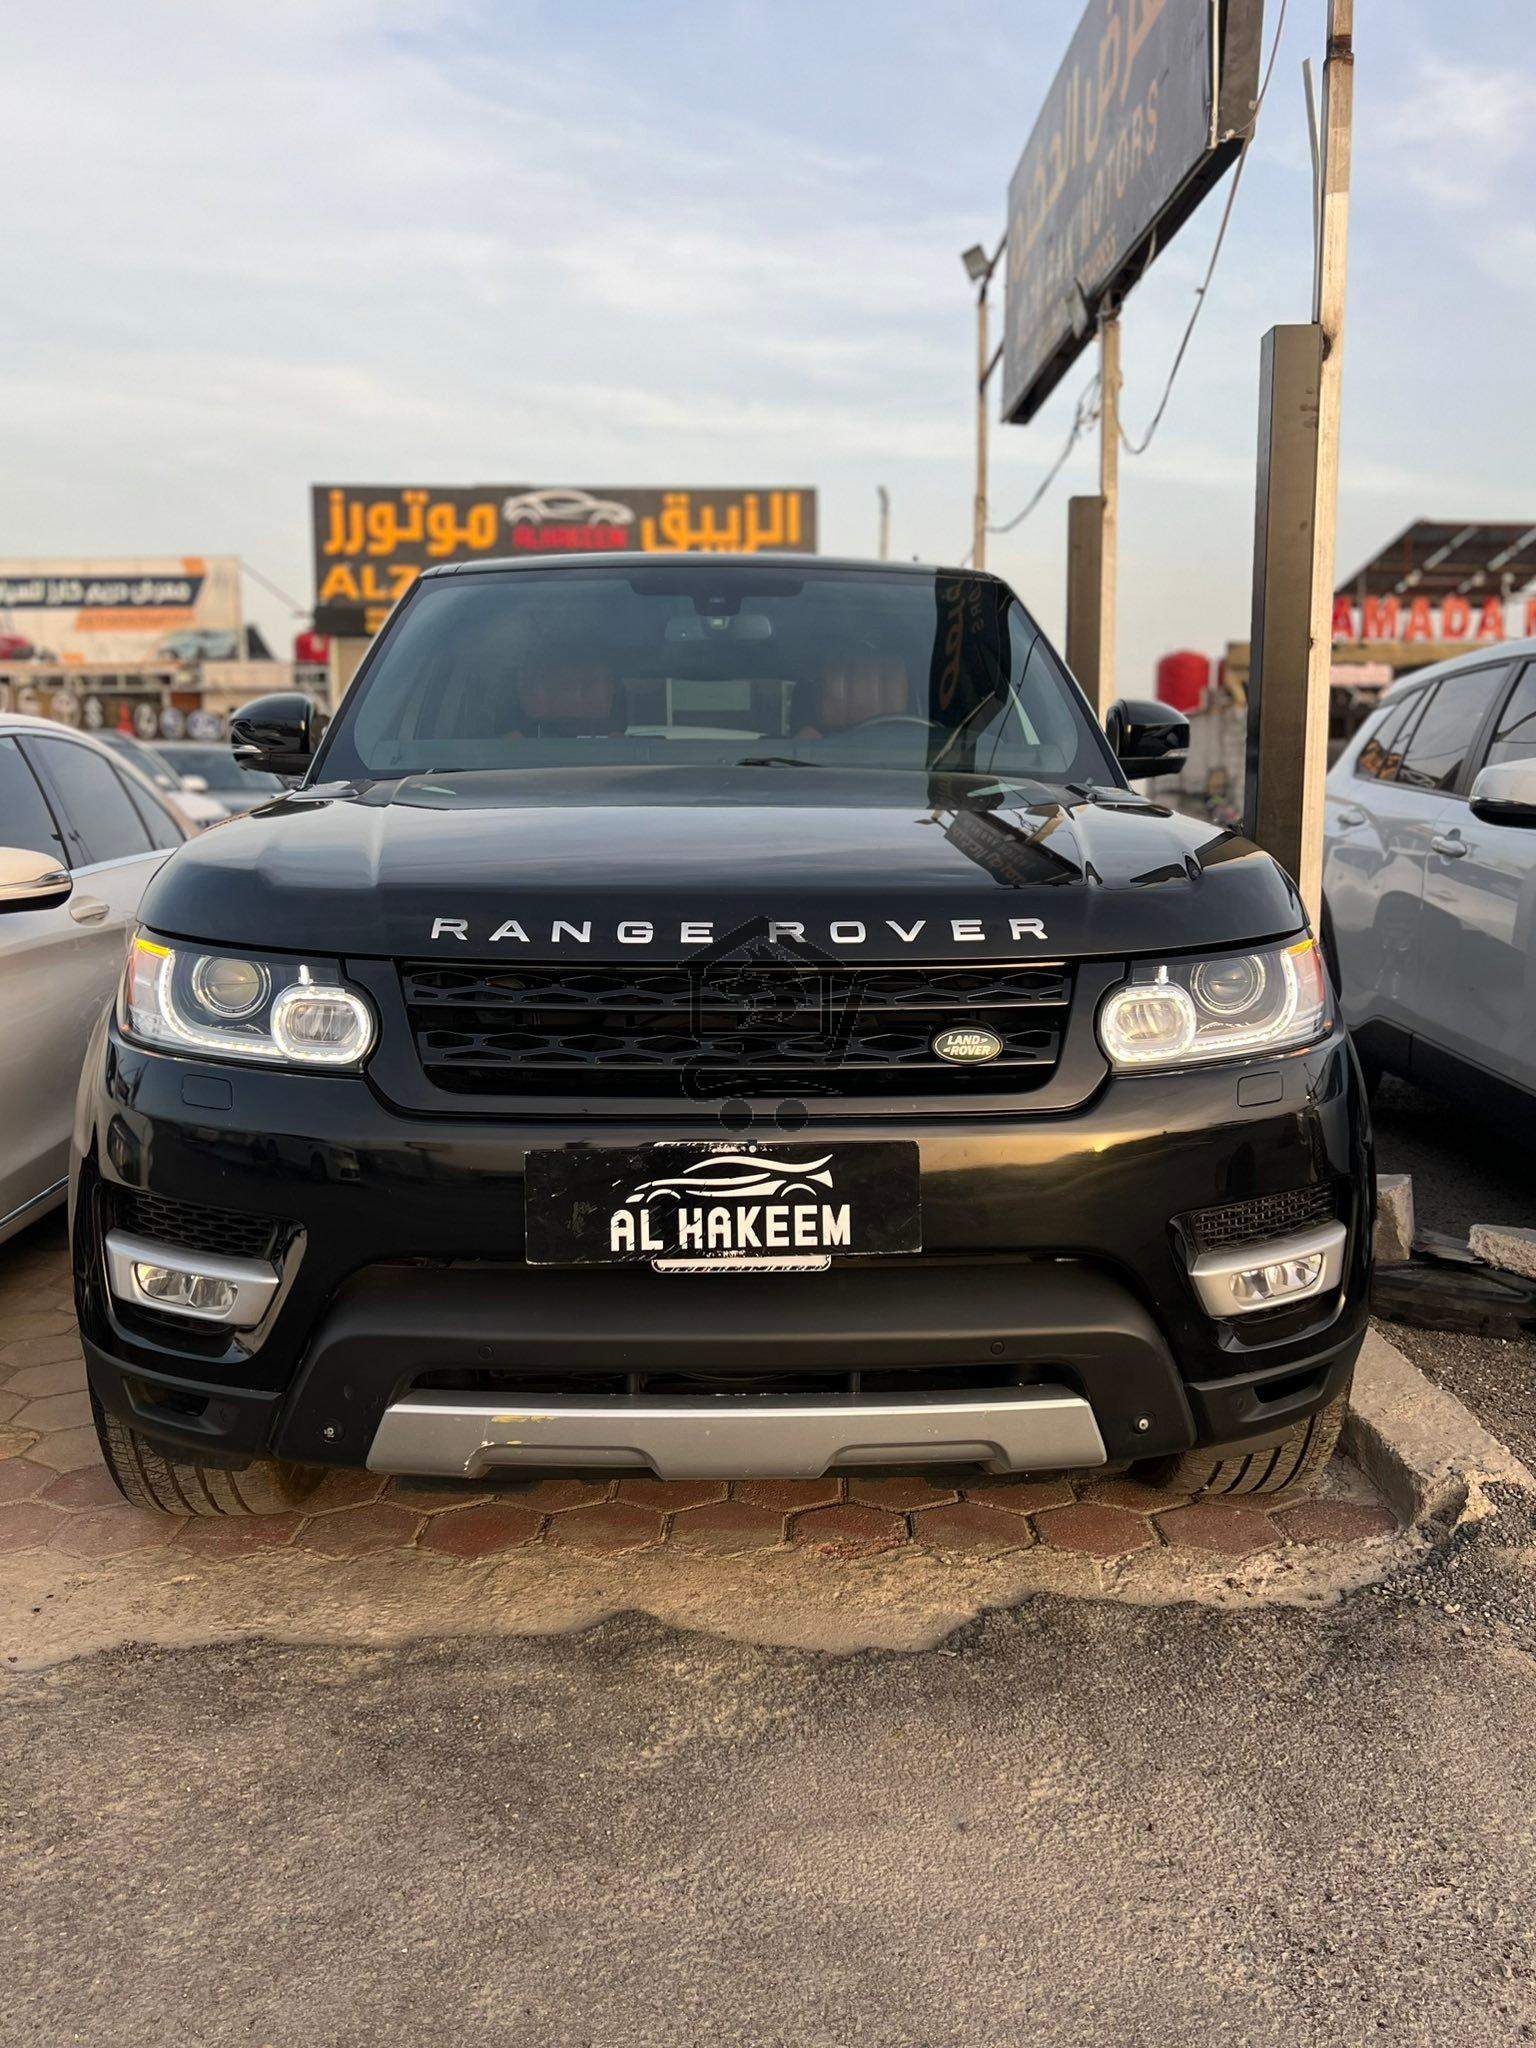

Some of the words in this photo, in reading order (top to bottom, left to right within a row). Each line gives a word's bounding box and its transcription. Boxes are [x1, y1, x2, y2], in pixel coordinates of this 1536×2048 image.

[323, 489, 498, 557] موتورز
[319, 563, 421, 603] ALZ
[430, 916, 714, 945] RANGE
[768, 916, 1049, 944] ROVER
[947, 1034, 981, 1046] LAND
[949, 1045, 992, 1057] ROVER
[610, 1208, 664, 1252] AL
[677, 1203, 851, 1251] HAKEEM
